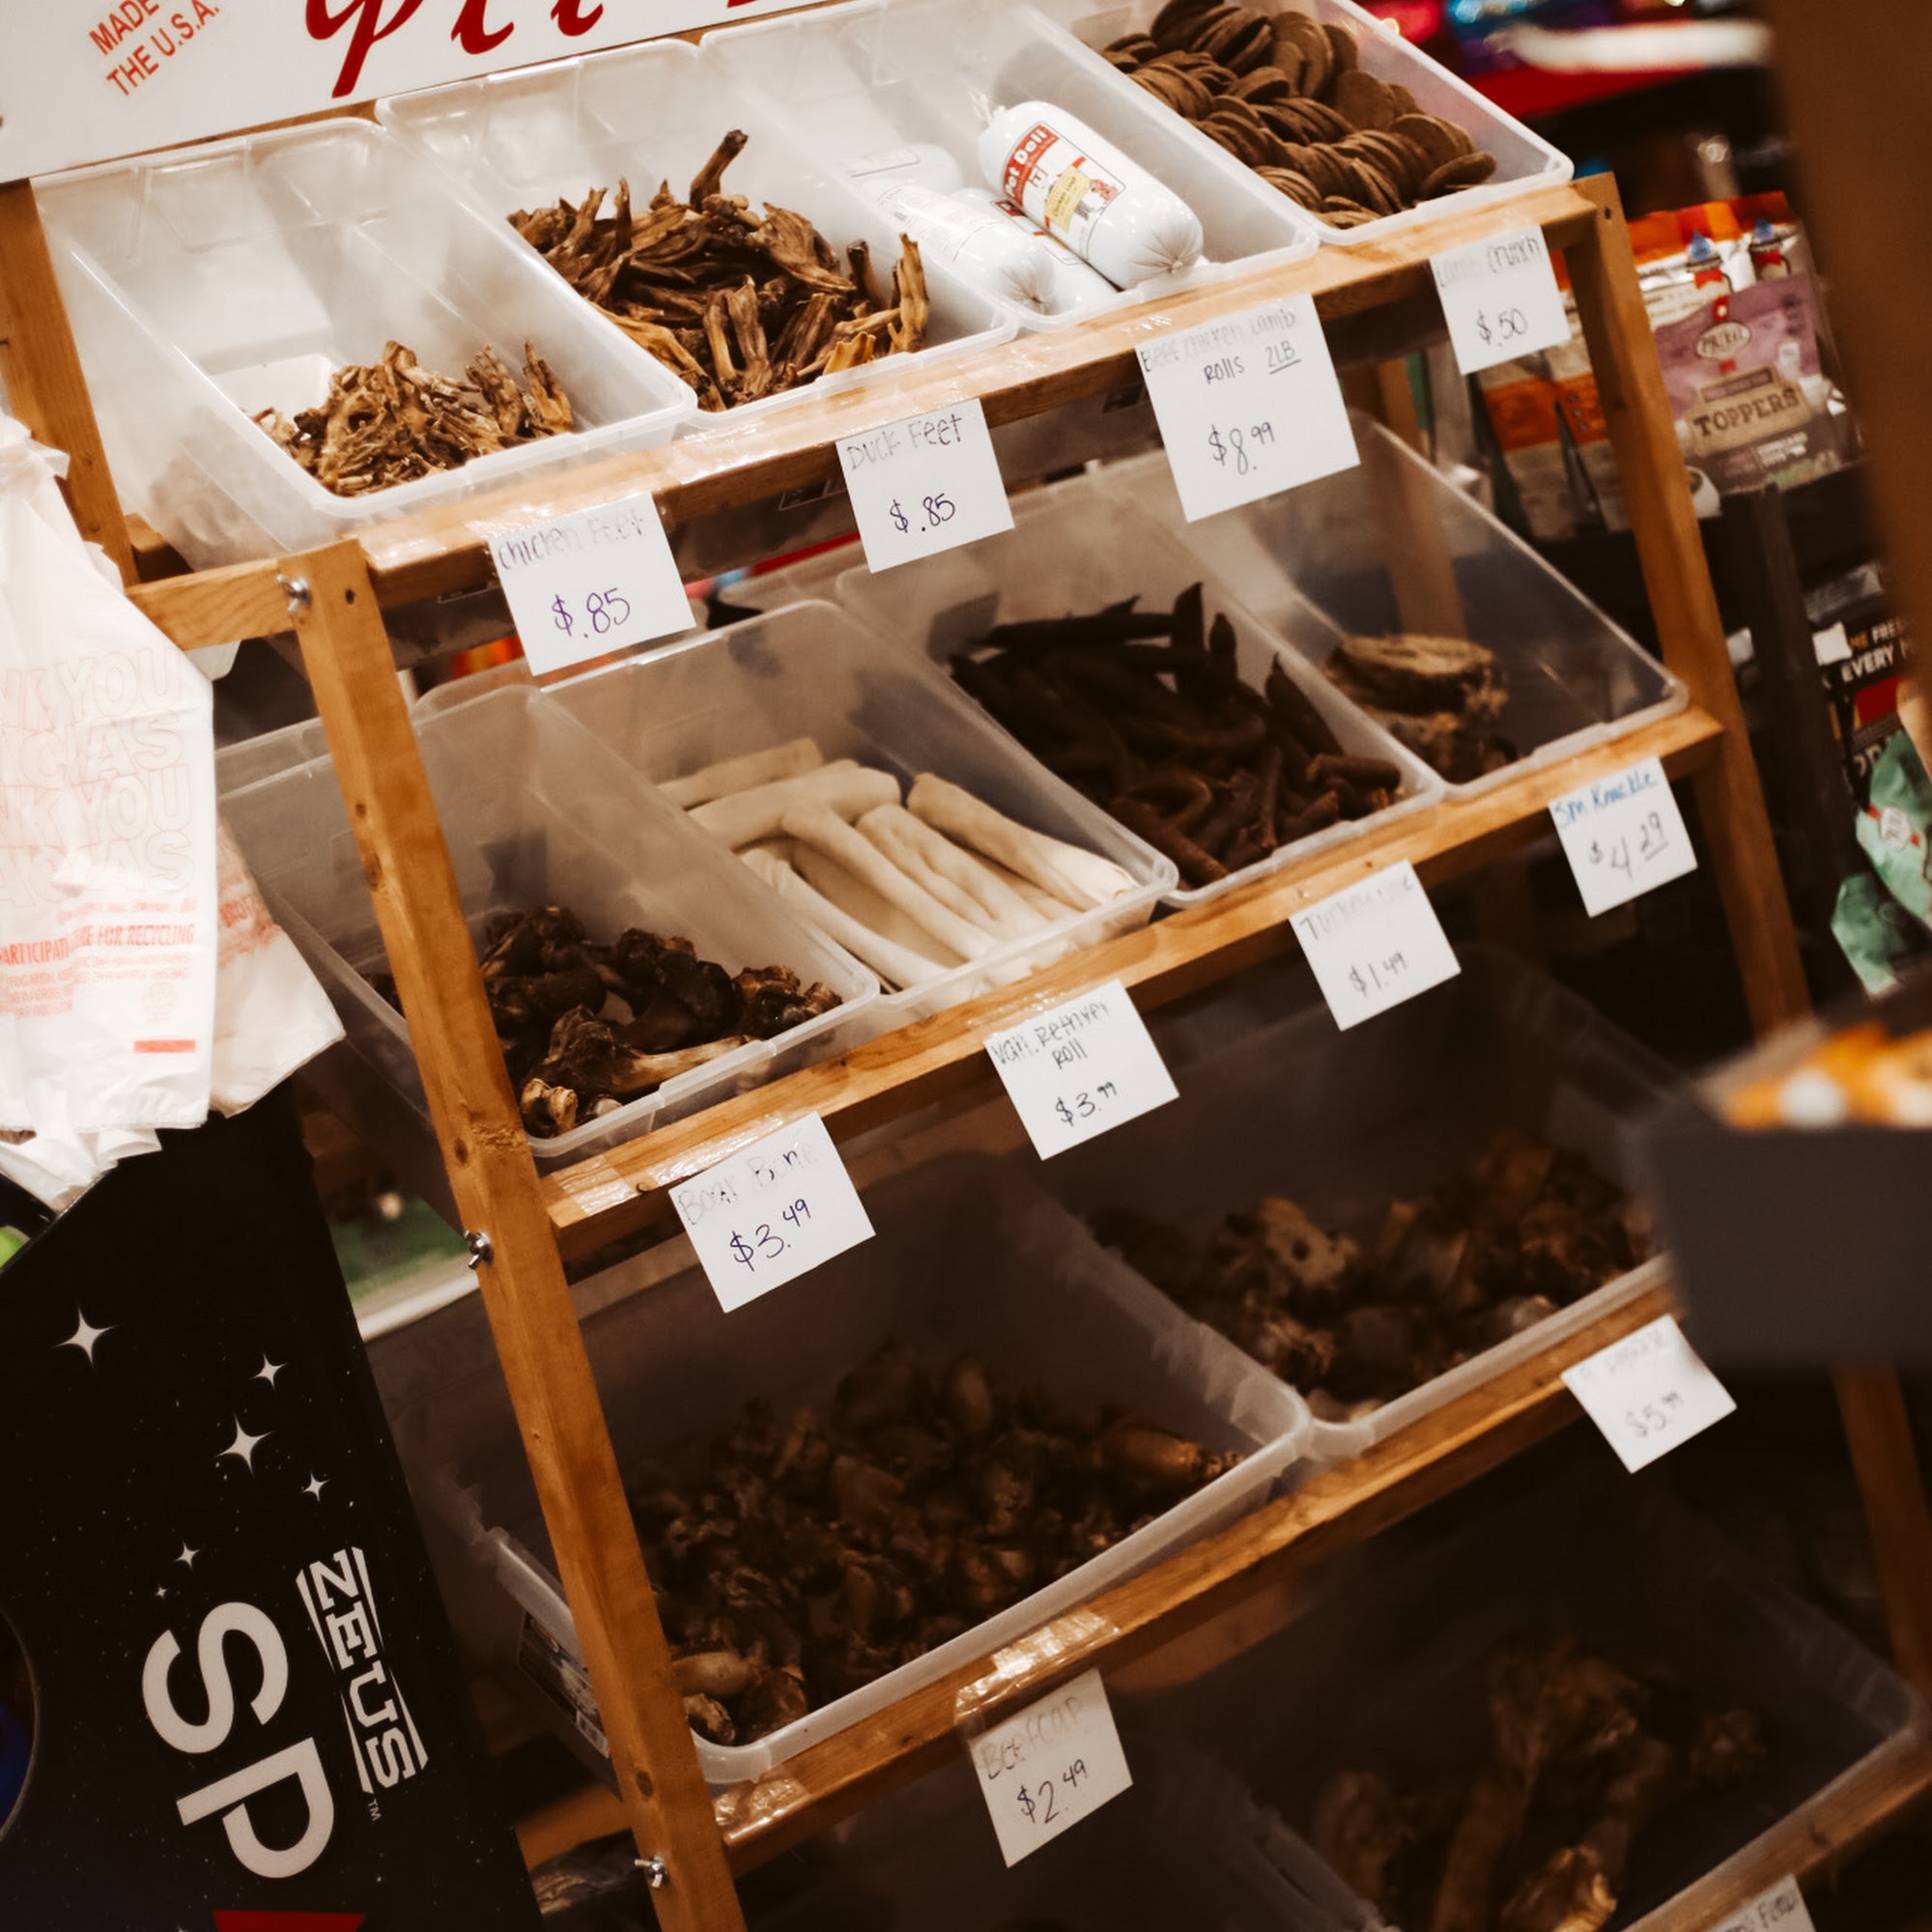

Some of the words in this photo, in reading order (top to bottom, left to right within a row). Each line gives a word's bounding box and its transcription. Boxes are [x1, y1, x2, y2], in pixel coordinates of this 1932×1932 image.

[106, 44, 160, 96] THE
[151, 0, 220, 57] U.S.A.
[1013, 128, 1048, 164] Deli
[1693, 388, 1800, 437] TOPPERS
[551, 587, 632, 639] $.85
[54, 648, 185, 726] YOU
[1840, 640, 1897, 683] EVERY
[128, 923, 195, 947] RECYCLING
[728, 1198, 812, 1272] $3.49
[309, 1548, 416, 1789] ZEUS
